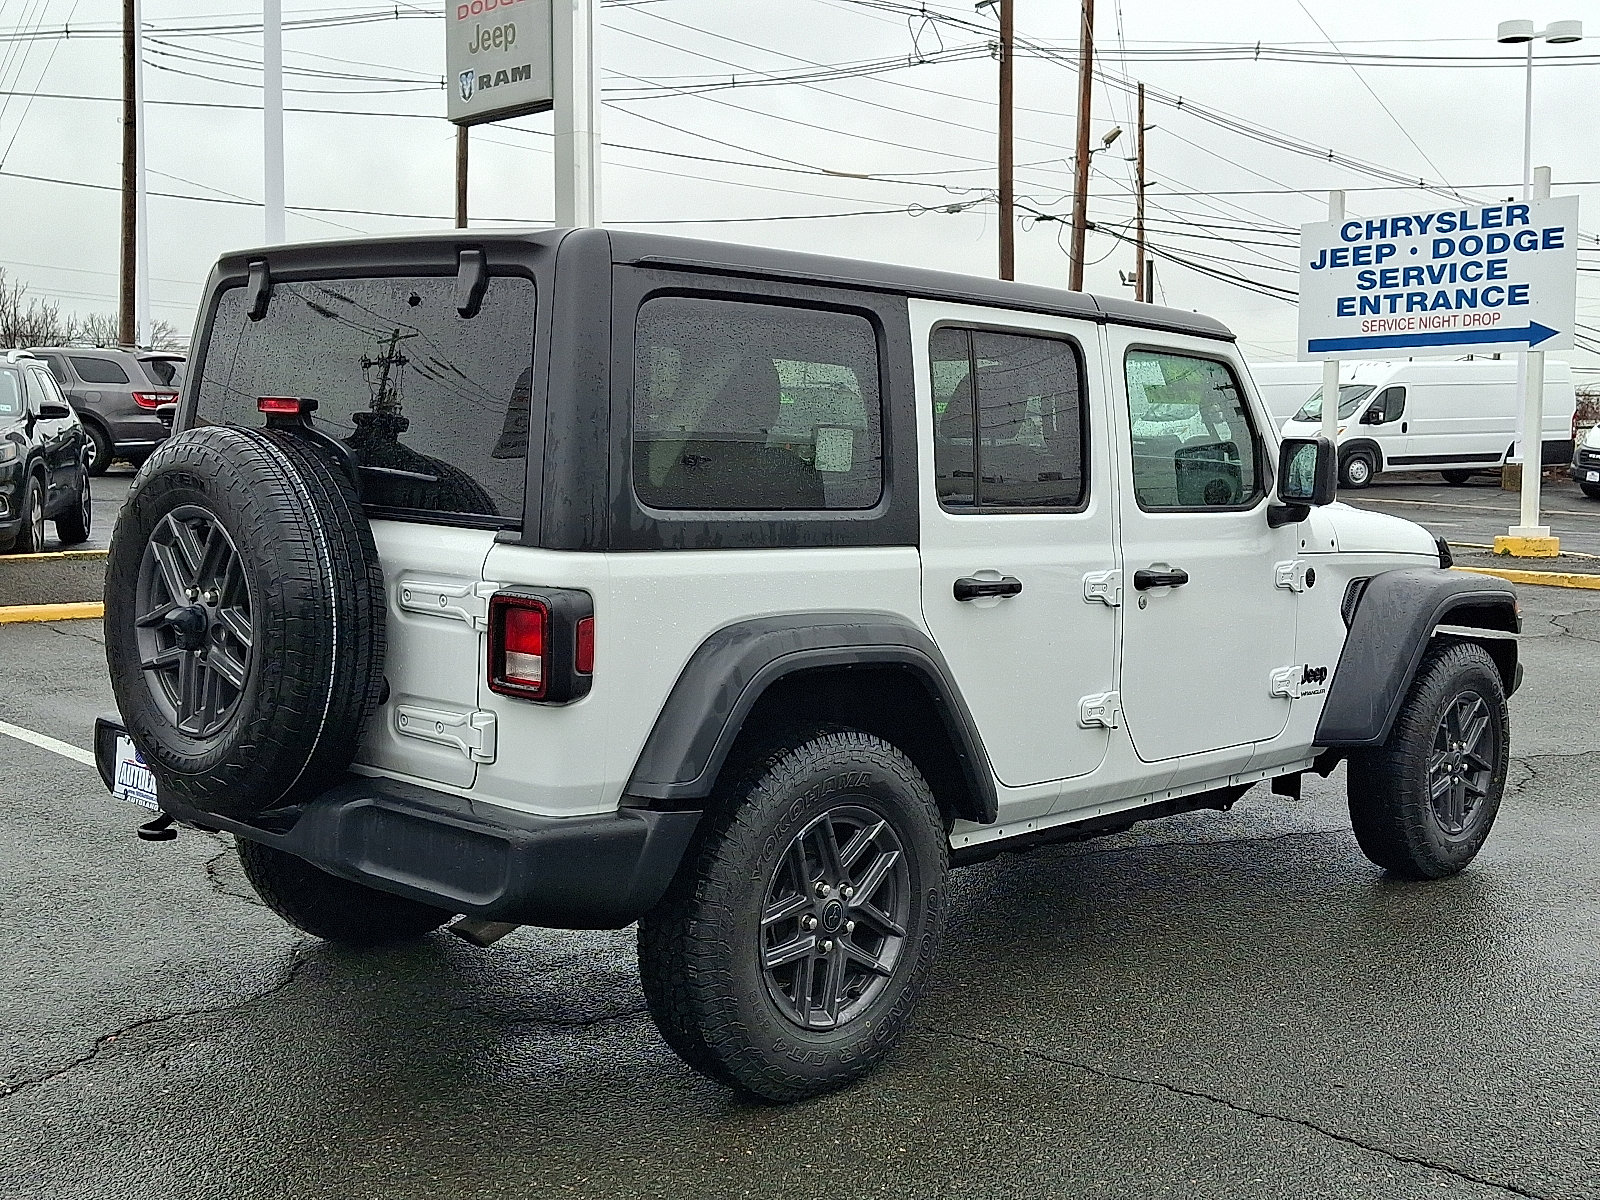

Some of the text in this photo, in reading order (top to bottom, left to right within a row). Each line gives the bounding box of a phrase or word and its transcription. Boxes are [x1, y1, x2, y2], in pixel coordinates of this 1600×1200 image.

[458, 0, 525, 20] DOD
[468, 22, 516, 54] Jeep
[478, 64, 532, 91] RAM
[1340, 204, 1530, 242] CHRYSLER
[1310, 227, 1565, 270] JEEP DODGE
[1357, 258, 1508, 290] SERVICE
[1336, 284, 1530, 317] ENTRANCE
[1361, 312, 1501, 333] SERVICE NIGHT DROP
[1301, 663, 1328, 685] Jeep
[750, 771, 872, 880] YOKOHAMA
